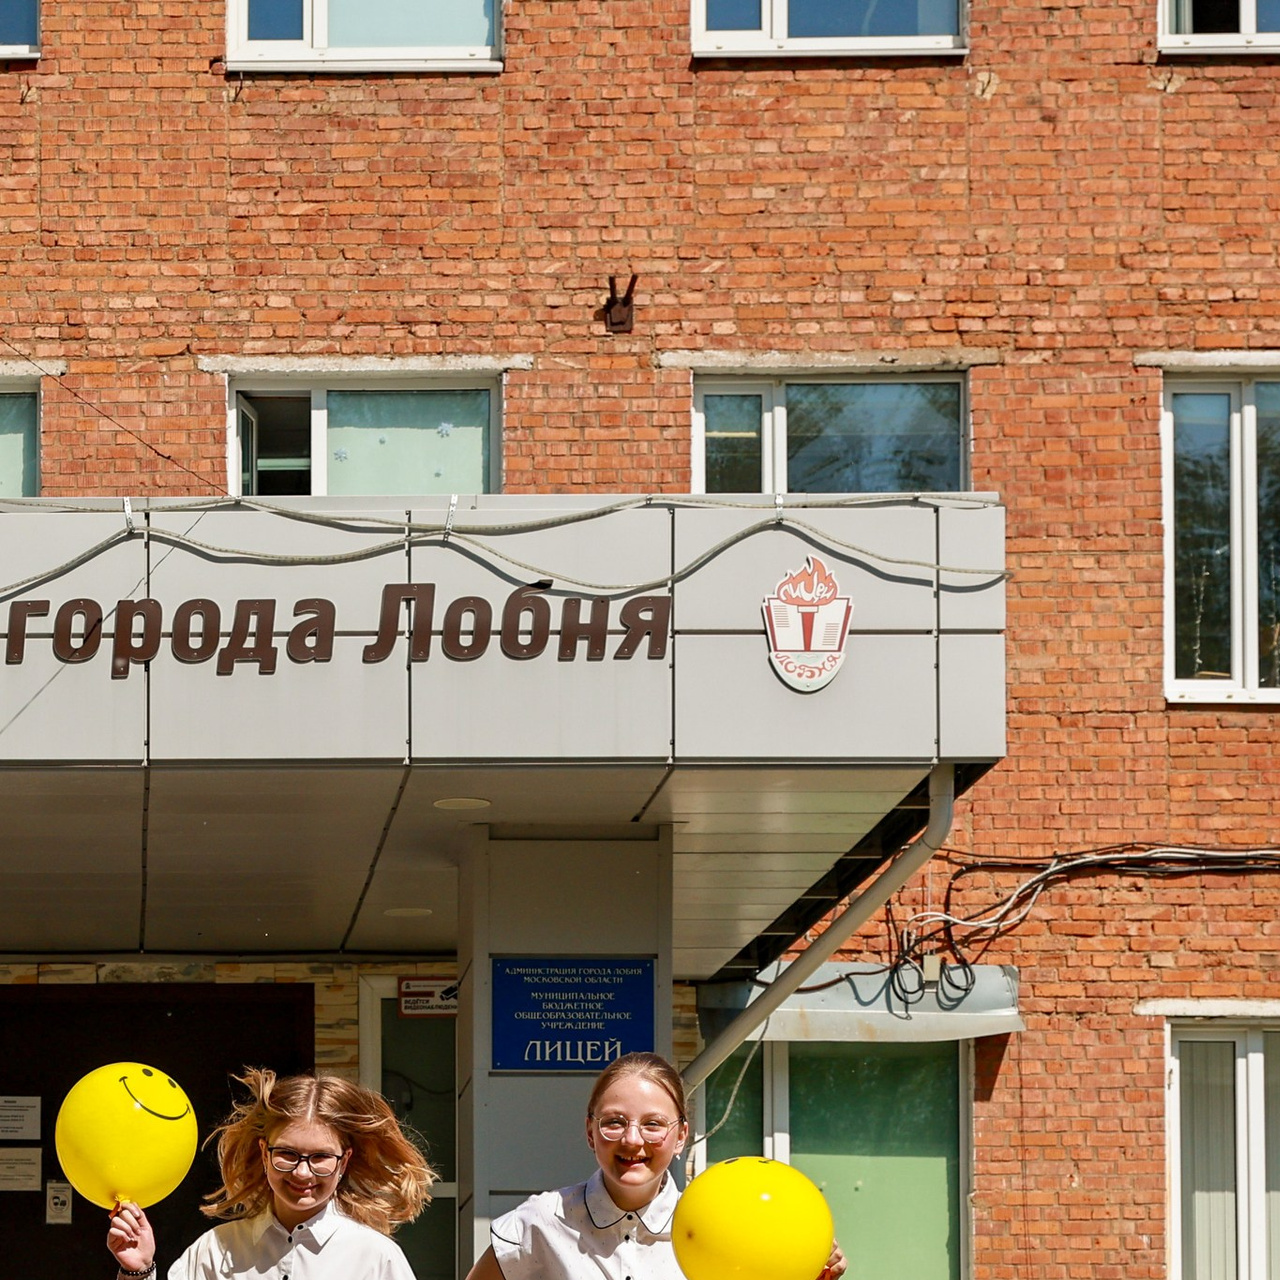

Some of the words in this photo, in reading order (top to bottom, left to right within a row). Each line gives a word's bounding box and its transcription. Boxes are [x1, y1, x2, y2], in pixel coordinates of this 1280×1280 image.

[5, 598, 336, 680] города
[362, 578, 671, 663] Лобня
[505, 967, 577, 975] АДМИНИСТРАЦИЯ
[578, 967, 612, 975] ГОРОДА
[613, 967, 642, 975] ЛОБНЯ
[584, 976, 623, 984] ОБЛАСТИ
[531, 992, 615, 1000] МУНИЦИПАЛЬНОЕ
[542, 1002, 604, 1010] БЮДЖЕТНОЕ
[514, 1012, 632, 1020] ОБЩЕОБРАЗОВАТЕЛЬНОЕ
[541, 1021, 605, 1030] УЧРЕЖДЕНИЕ
[524, 1037, 622, 1064] ЛИЦЕЙ
